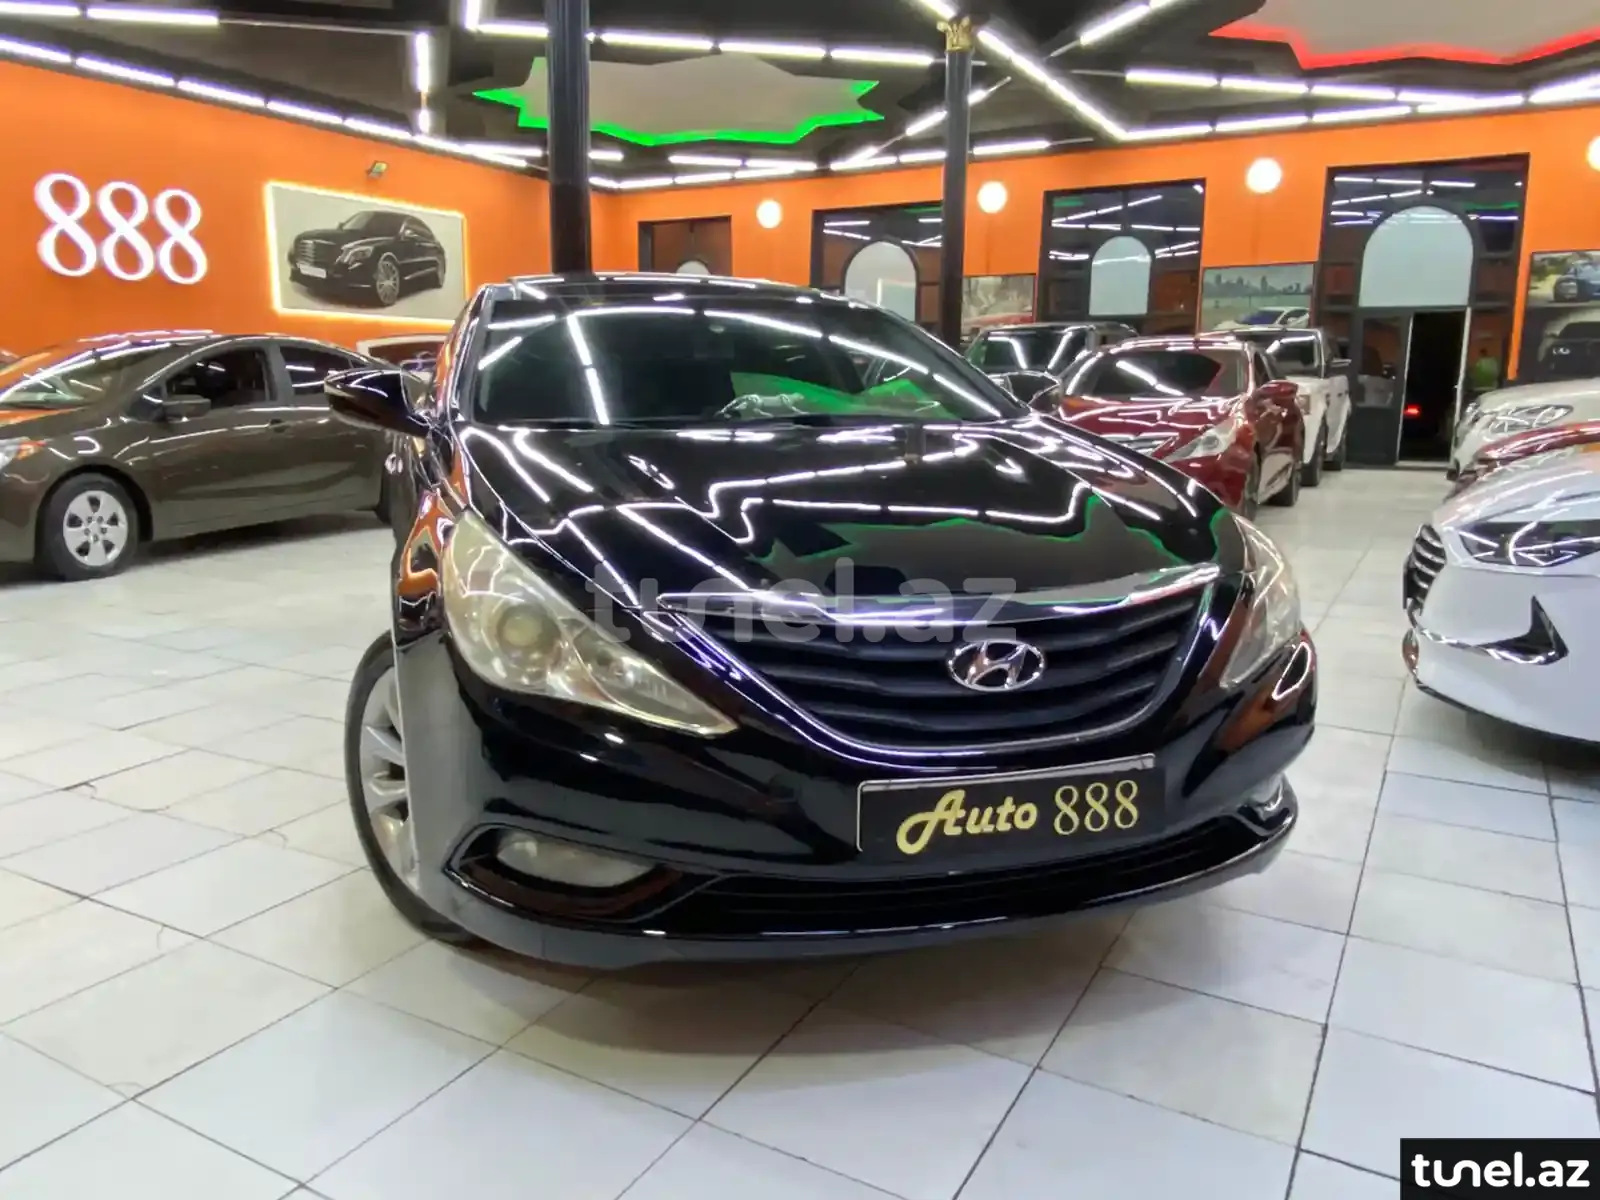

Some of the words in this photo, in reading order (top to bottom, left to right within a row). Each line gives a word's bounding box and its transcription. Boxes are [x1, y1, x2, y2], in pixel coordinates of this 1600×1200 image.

[34, 172, 208, 285] 888
[896, 789, 1038, 855] Auto
[1053, 779, 1138, 836] 888
